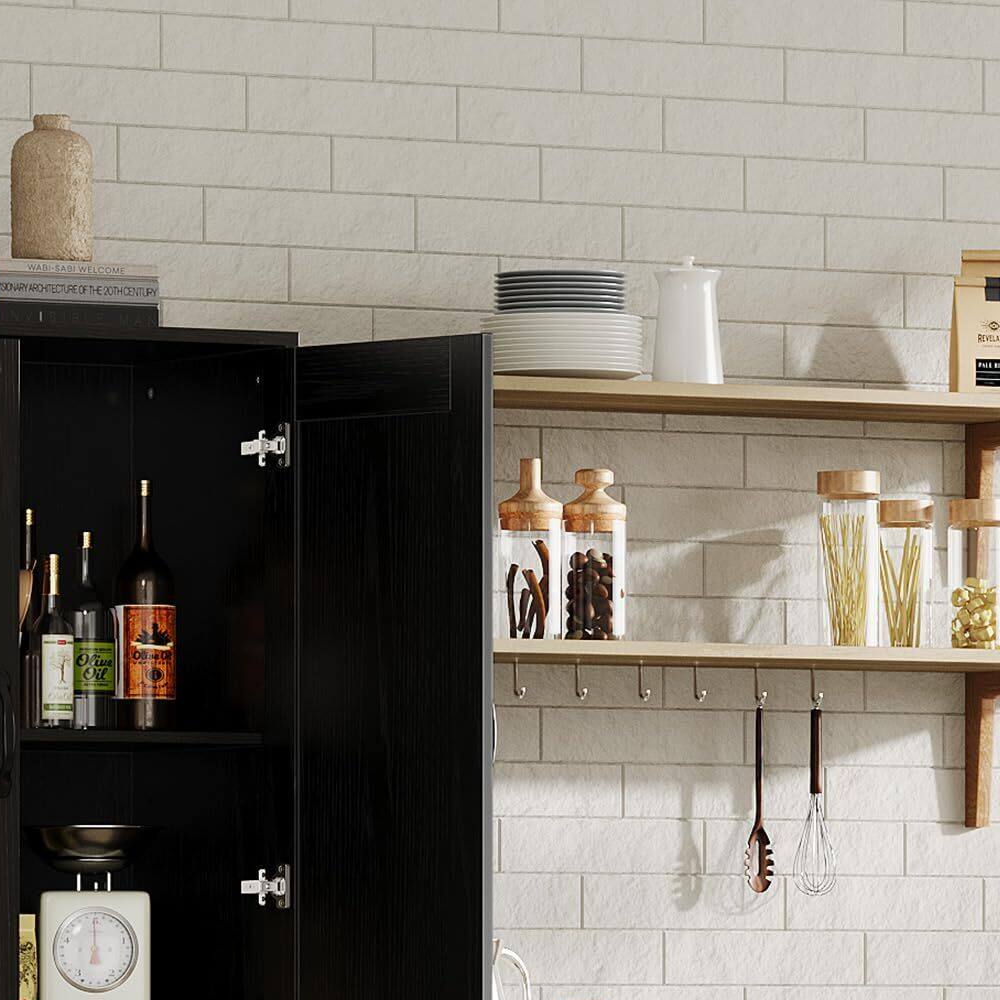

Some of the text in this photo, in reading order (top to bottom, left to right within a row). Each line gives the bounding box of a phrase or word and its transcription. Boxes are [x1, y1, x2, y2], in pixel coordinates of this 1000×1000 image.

[27, 263, 126, 275] WABI-SABI WELCOME
[28, 283, 78, 294] ARCHITECTURE
[79, 285, 87, 295] OF
[89, 285, 103, 296] THE
[103, 286, 123, 297] 20TH
[123, 286, 158, 298] CENTURY
[75, 653, 113, 668] Olive
[83, 667, 109, 681] Oil
